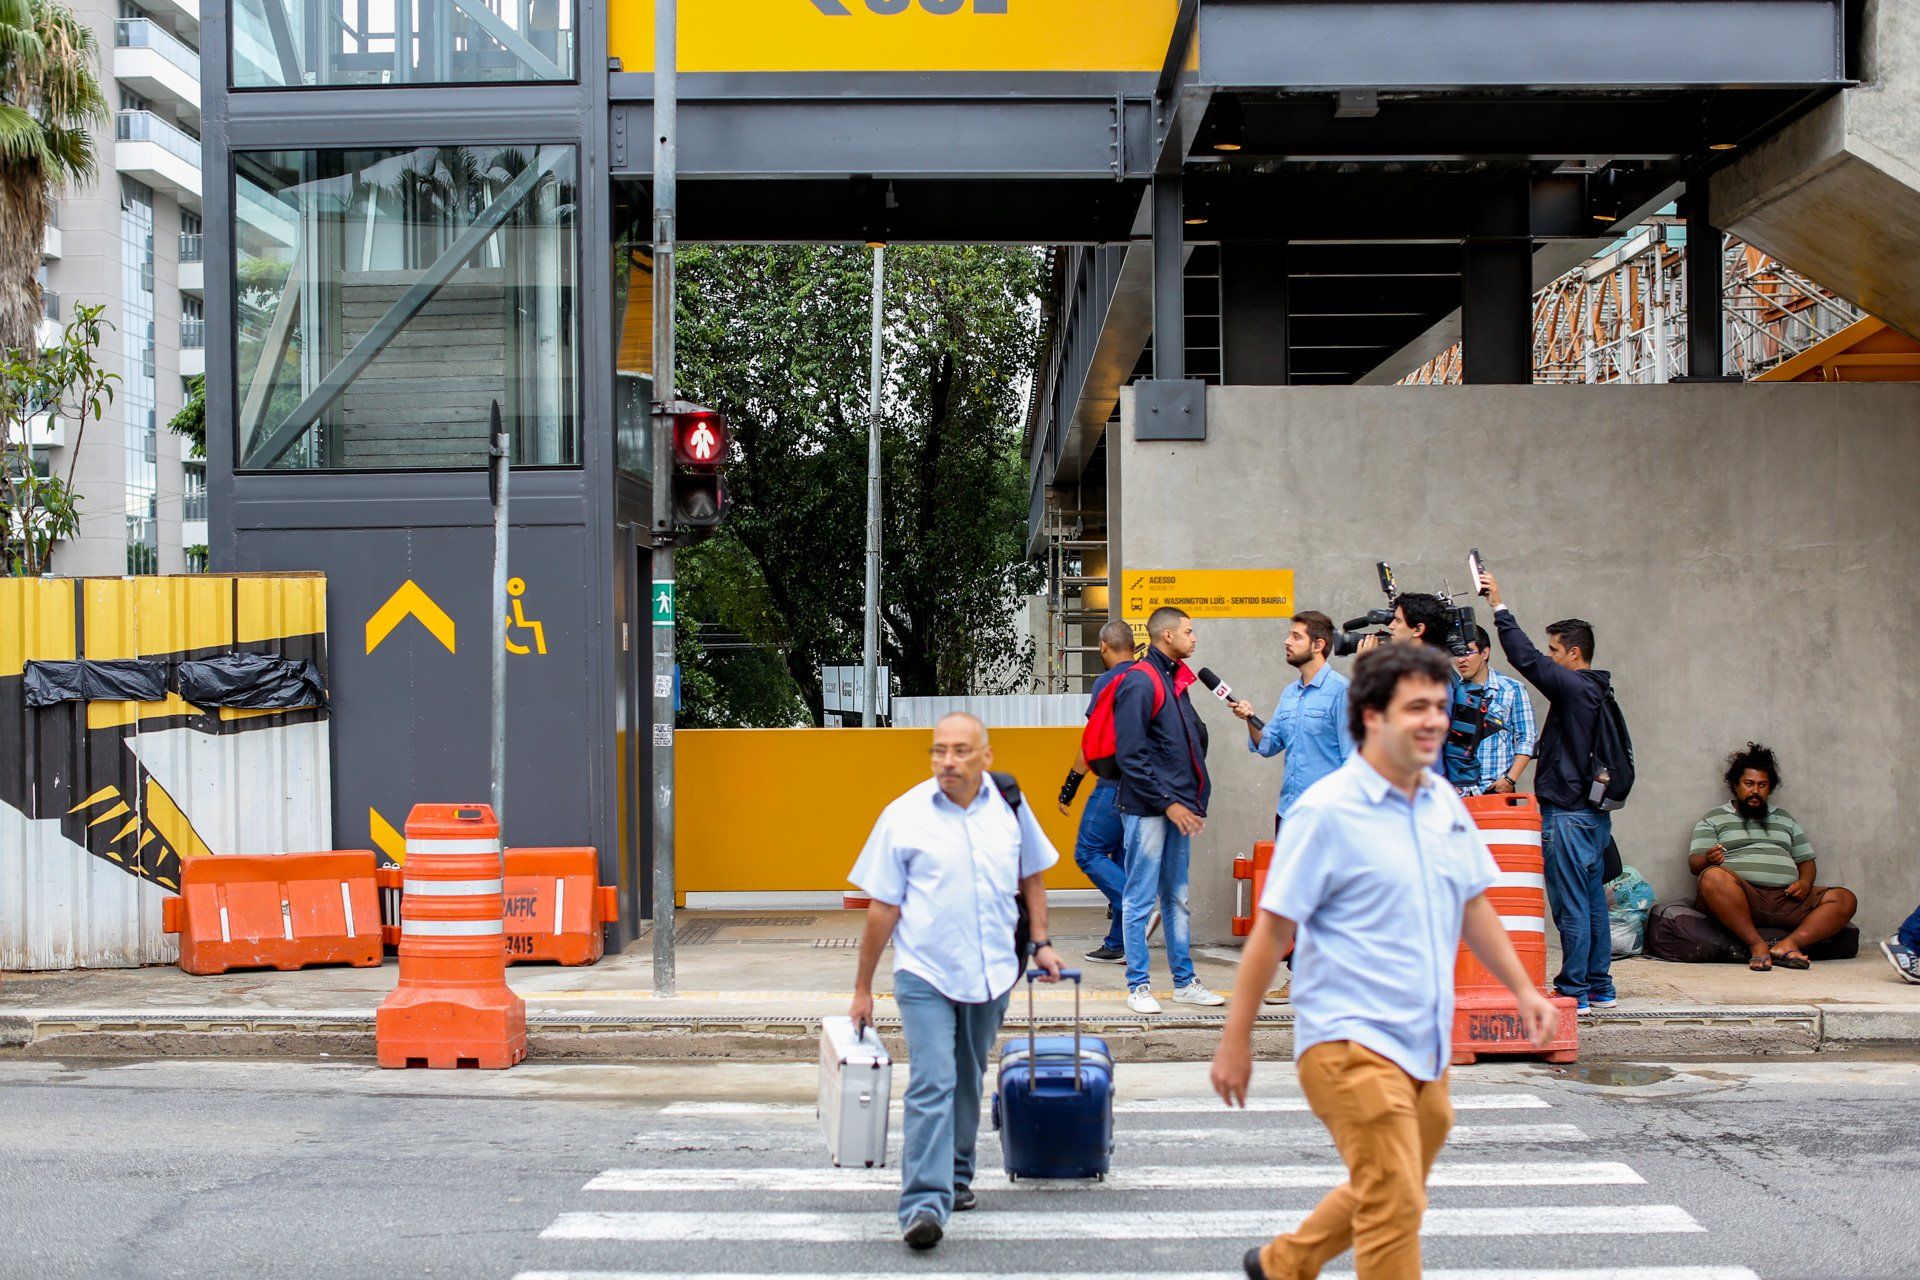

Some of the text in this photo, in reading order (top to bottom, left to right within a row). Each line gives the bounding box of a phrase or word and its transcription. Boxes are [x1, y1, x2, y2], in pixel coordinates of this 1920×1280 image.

[1149, 576, 1176, 584] ACESSO
[1210, 594, 1225, 604] LUÍS
[1231, 596, 1260, 604] SENTIDO
[1261, 596, 1287, 604] BAIRRO
[1216, 685, 1228, 697] G1
